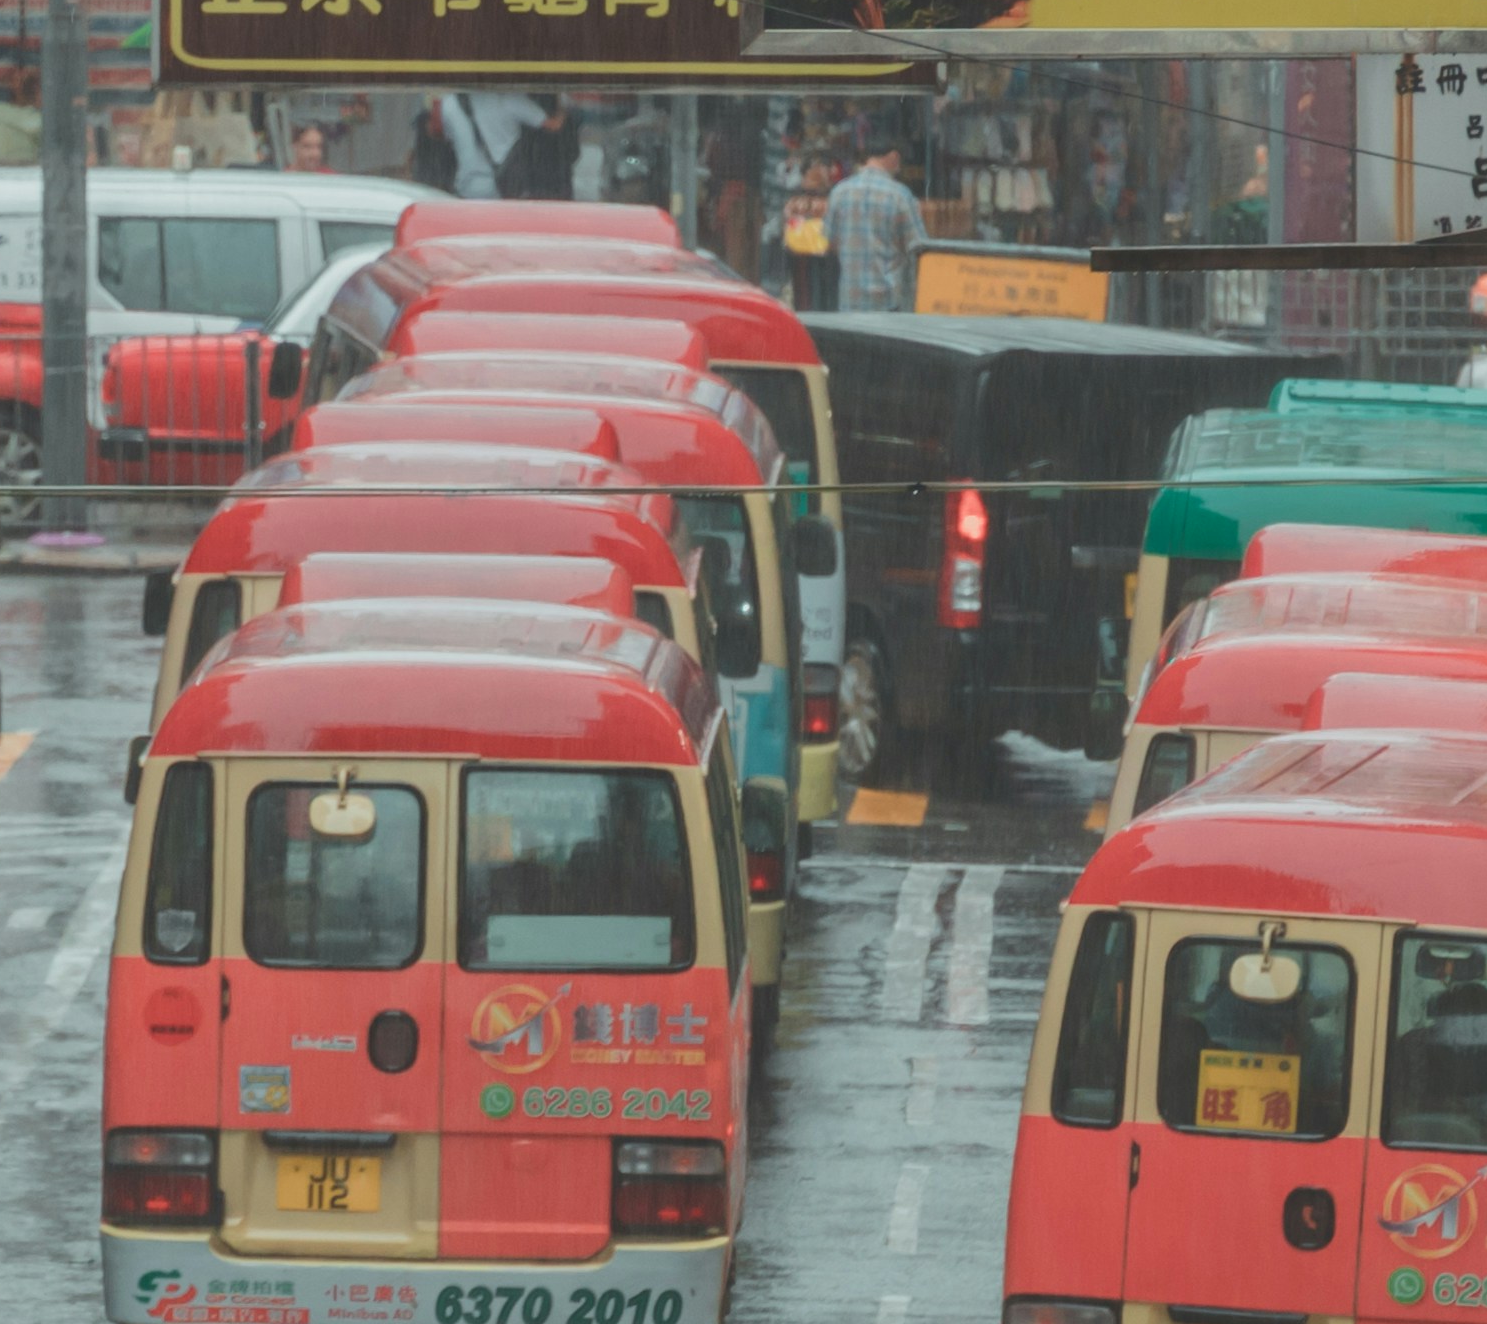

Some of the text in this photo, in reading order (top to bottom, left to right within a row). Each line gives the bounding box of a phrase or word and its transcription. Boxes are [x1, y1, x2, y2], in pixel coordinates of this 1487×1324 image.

[570, 1049, 632, 1064] MONEY
[523, 1086, 713, 1120] 6286 2042
[1202, 1087, 1292, 1131] 旺角
[307, 1183, 350, 1209] 112
[326, 1284, 418, 1303] 小巴廣告
[327, 1307, 414, 1321] Minibus AD
